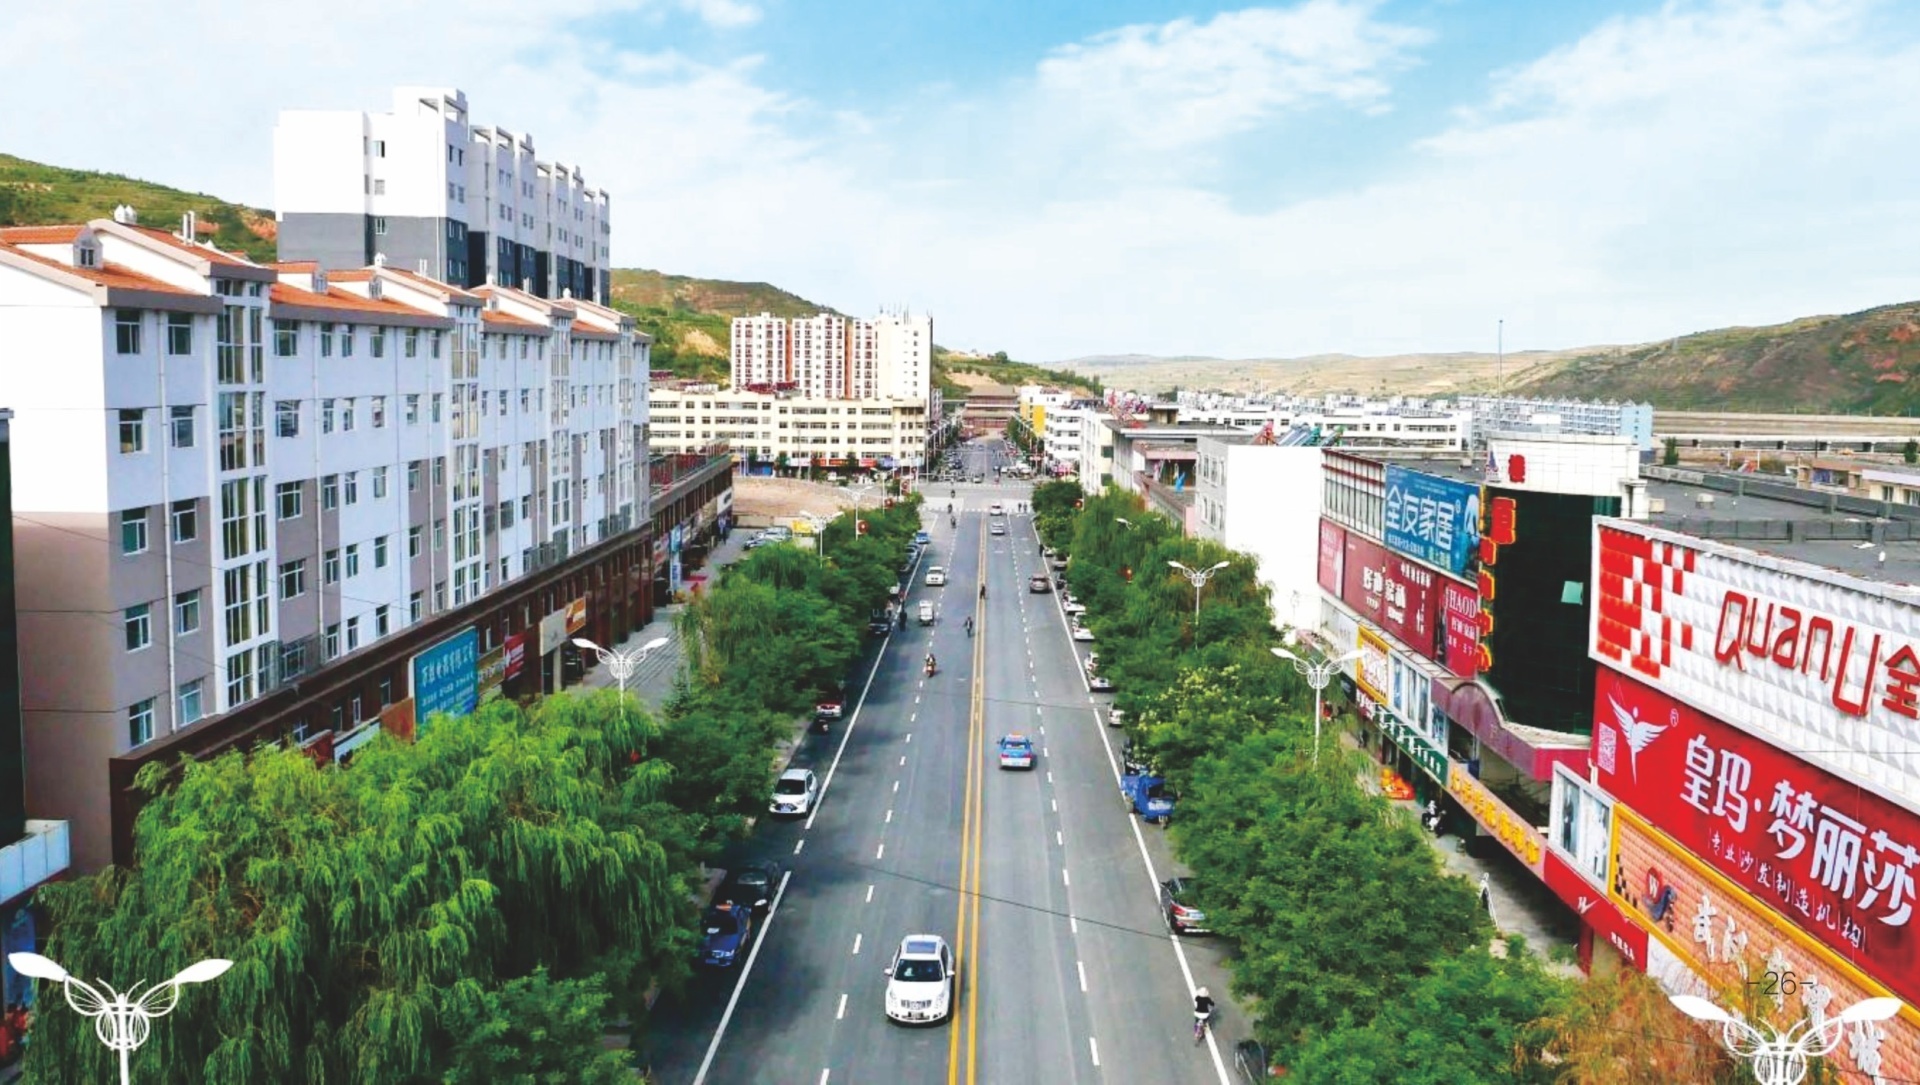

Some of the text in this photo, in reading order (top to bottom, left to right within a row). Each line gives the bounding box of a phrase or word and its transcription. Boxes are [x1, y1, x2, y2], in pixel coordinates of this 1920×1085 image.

[1386, 484, 1455, 551] 全友家居
[1711, 830, 1862, 949] 专业沙发制造机构
